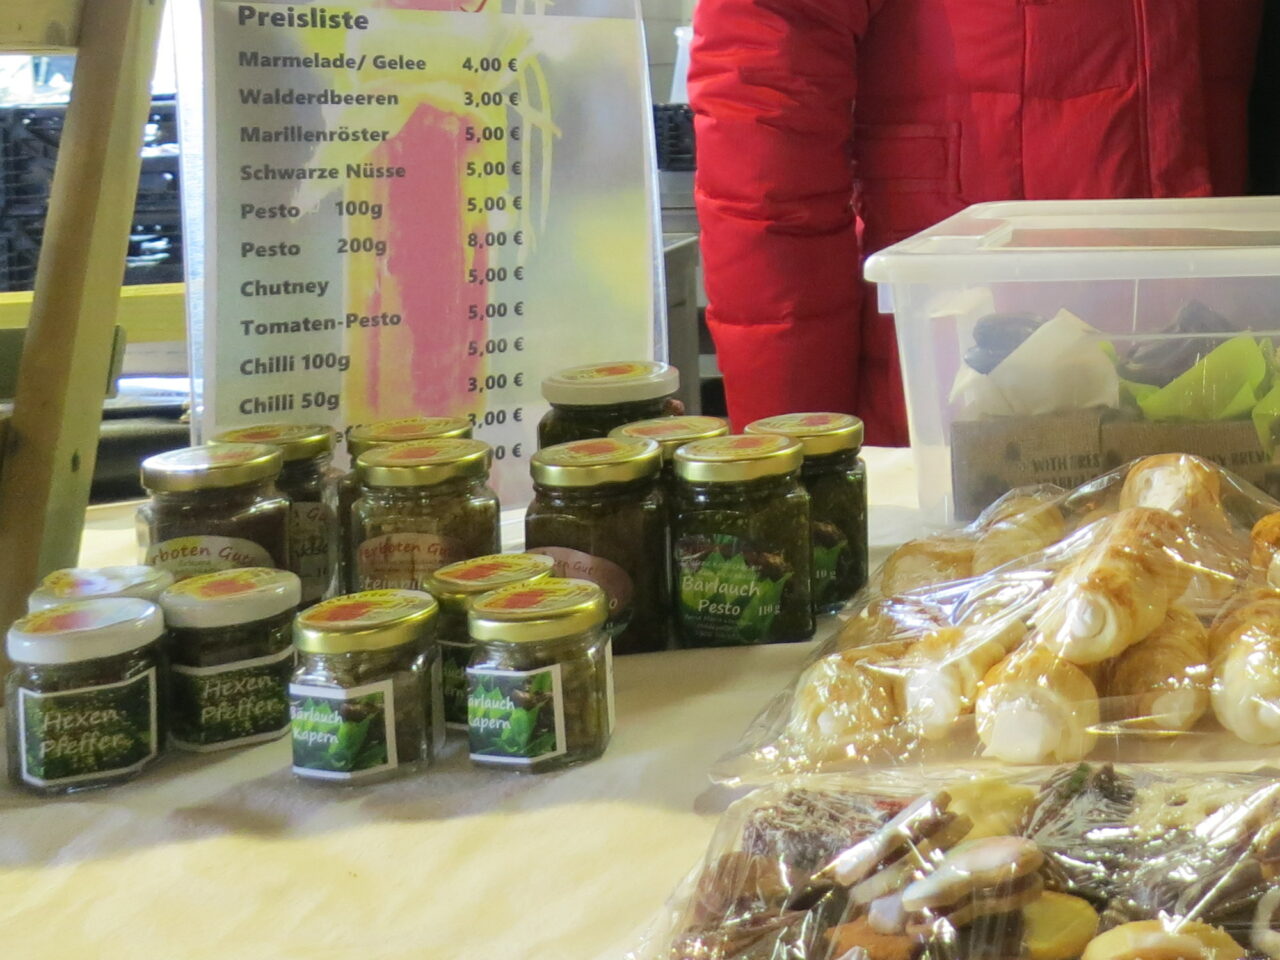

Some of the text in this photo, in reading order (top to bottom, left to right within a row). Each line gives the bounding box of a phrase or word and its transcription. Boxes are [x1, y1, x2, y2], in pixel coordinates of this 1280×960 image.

[238, 5, 370, 31] Preisliste
[373, 54, 427, 71] Gelee
[462, 56, 502, 74] 4,00
[508, 58, 518, 72] €
[239, 88, 520, 108] Walderdbeeren 3,00 €
[240, 124, 520, 144] Marillenröster 5,00 €
[240, 161, 522, 181] Schwarze Nüsse 5,00 €
[241, 197, 523, 220] Pesto 100g 5,00 €
[241, 231, 523, 259] Pesto 200g 8,00 €
[240, 267, 524, 298] Chutney 5,00 €
[241, 302, 524, 336] Tomaten-Pesto 5,00 €
[240, 338, 524, 376] Chilli 100g 5,00 €
[239, 373, 524, 416] Chilli 50g 3,00 €
[513, 409, 523, 424] €
[511, 444, 522, 459] €
[151, 544, 211, 566] rboten
[698, 599, 742, 617] Pesto
